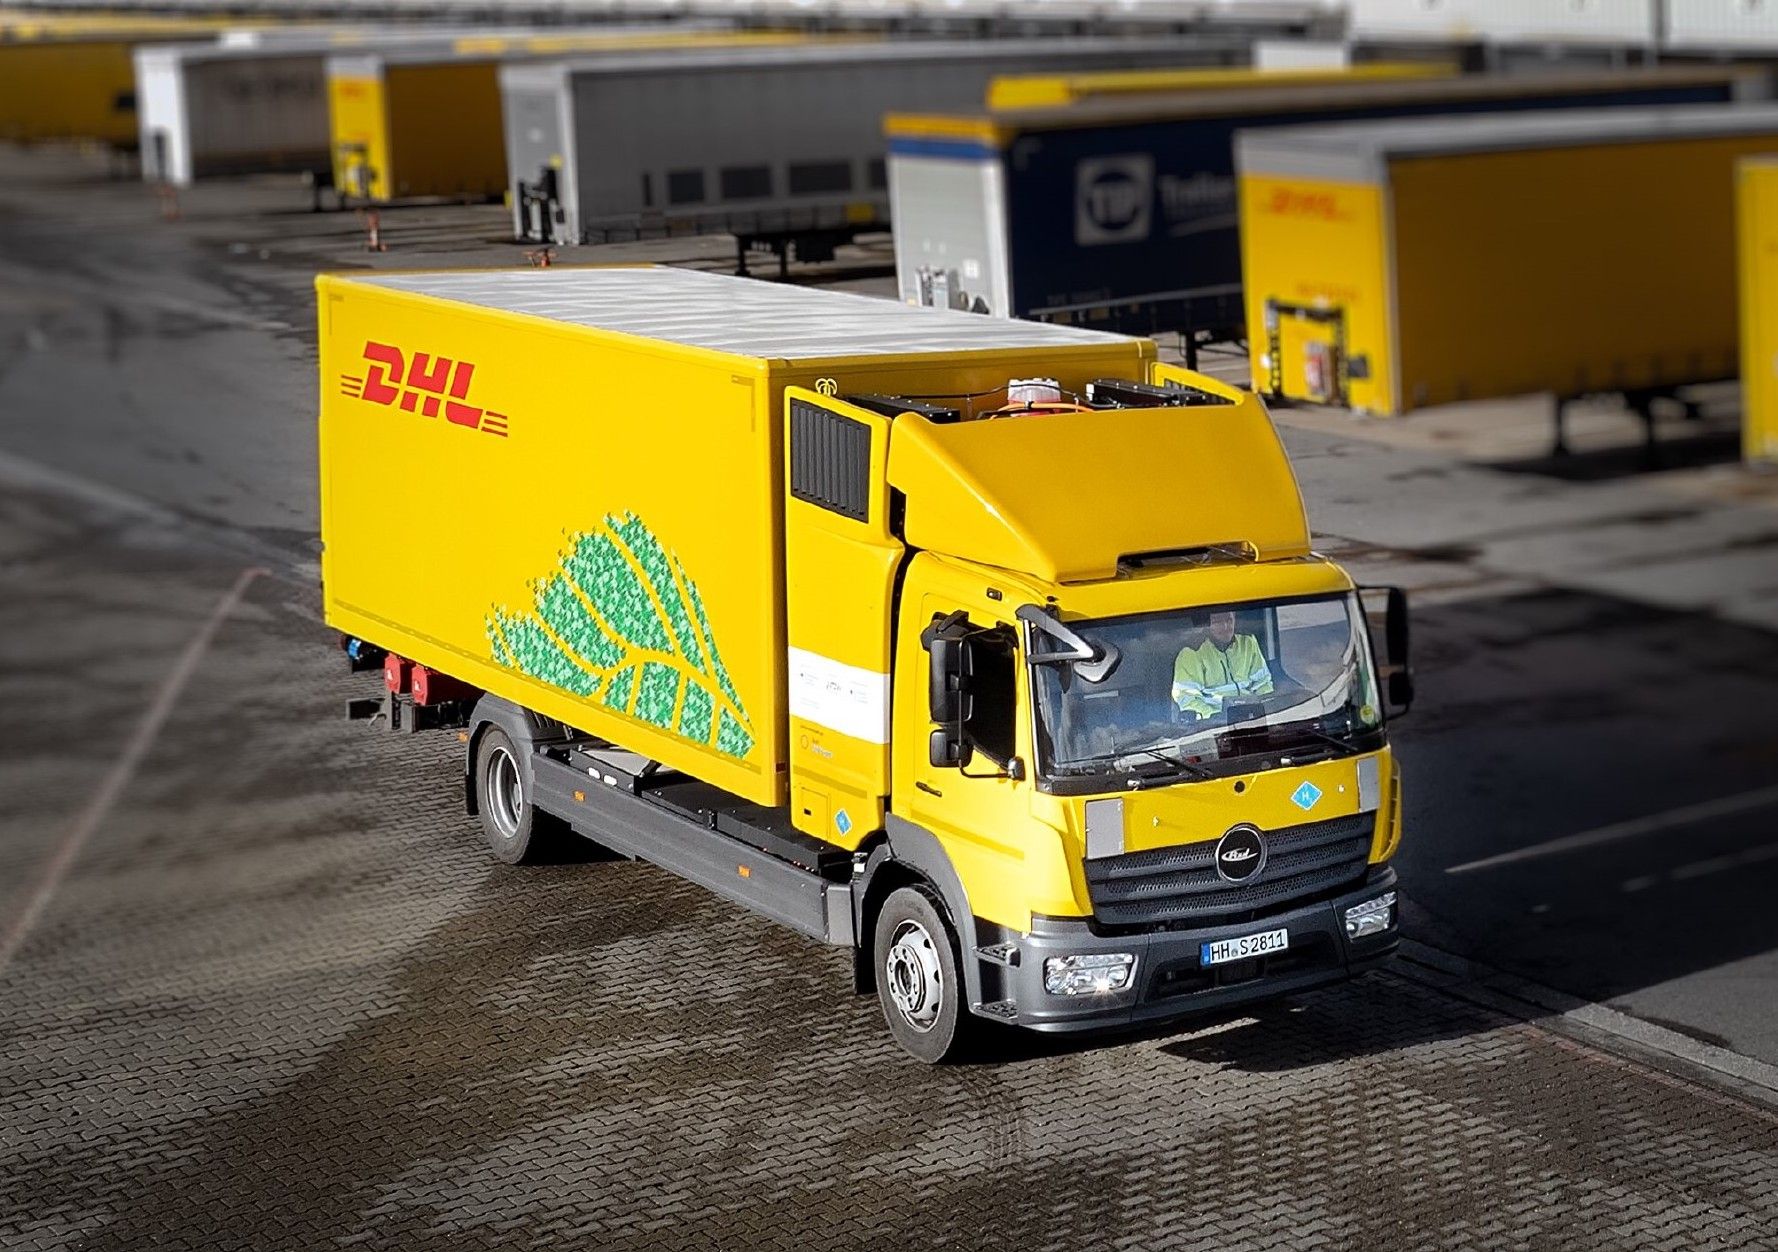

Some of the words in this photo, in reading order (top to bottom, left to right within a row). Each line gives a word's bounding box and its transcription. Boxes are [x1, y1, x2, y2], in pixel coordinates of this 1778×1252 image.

[362, 340, 483, 430] DHL
[1211, 942, 1230, 961] HH
[1240, 939, 1248, 955] S
[1251, 931, 1284, 953] 2811
